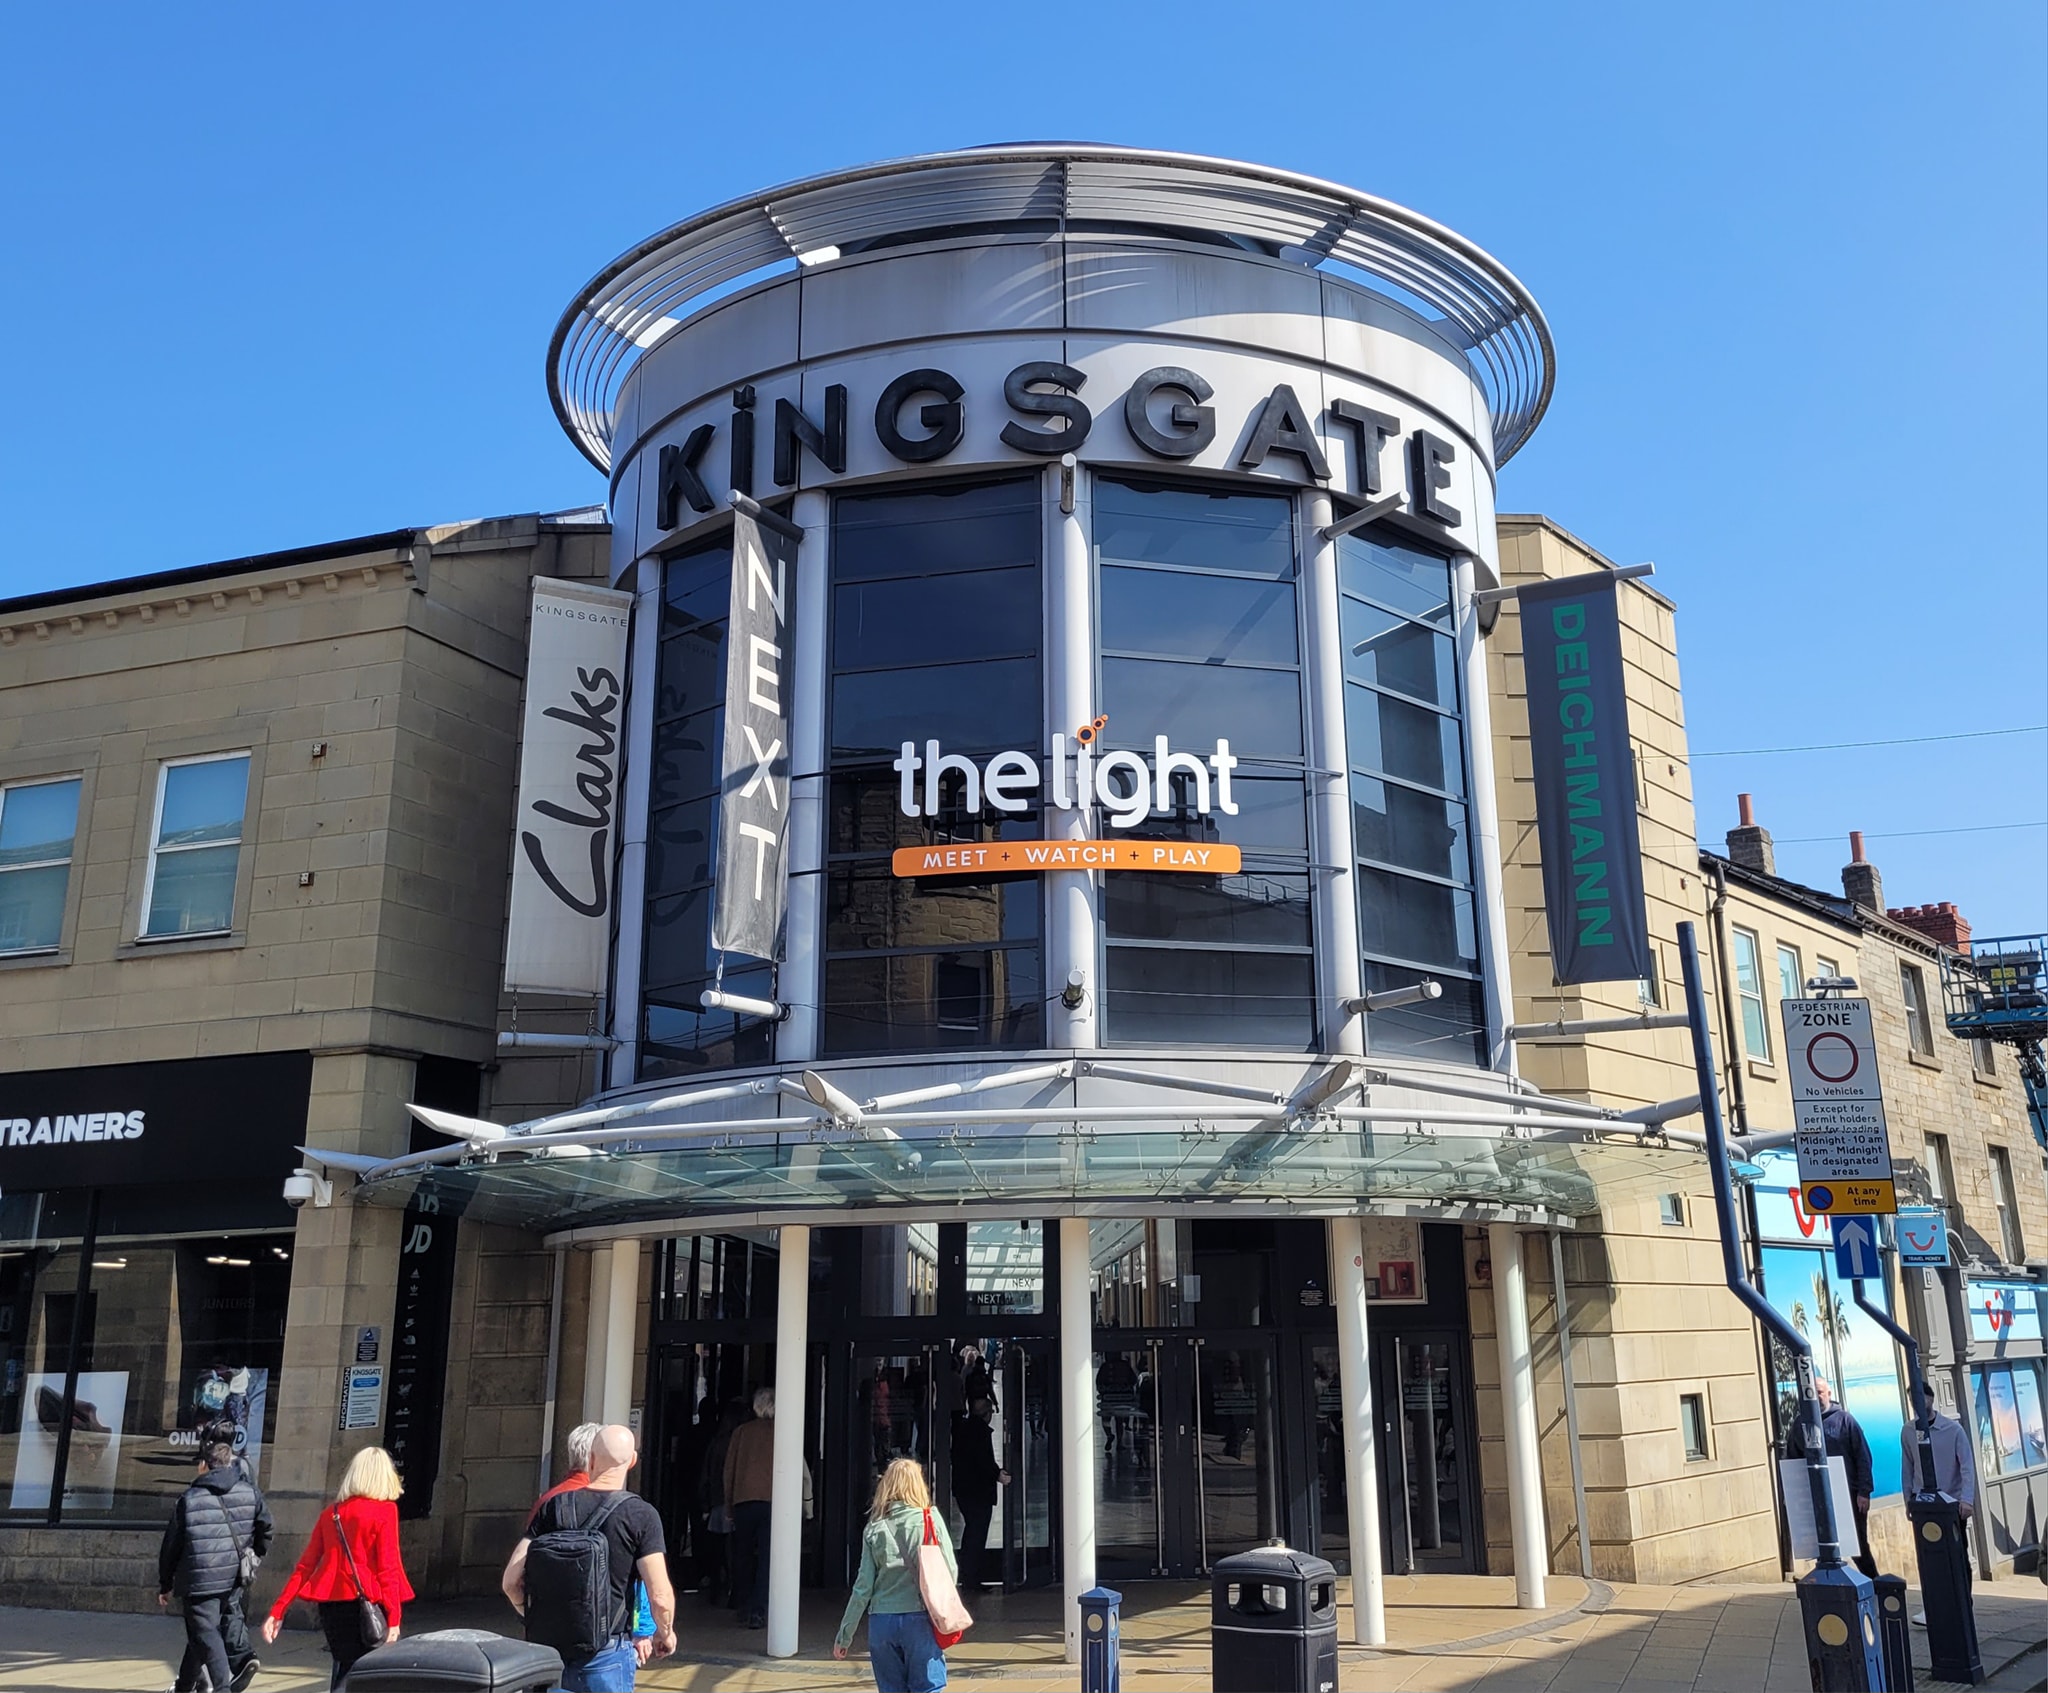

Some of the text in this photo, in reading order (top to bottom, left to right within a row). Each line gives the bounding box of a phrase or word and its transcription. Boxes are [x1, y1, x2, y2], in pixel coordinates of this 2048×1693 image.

[656, 360, 1462, 528] KINGSGATE
[535, 604, 628, 627] KINGSGATE
[739, 540, 786, 901] NEXT
[1552, 603, 1614, 947] DEICHMANN
[521, 666, 621, 918] Clarks
[923, 849, 988, 869] MEET
[1025, 847, 1115, 863] WATCH
[1153, 847, 1211, 865] PLAY
[1791, 1003, 1860, 1012] PEDESTRIAN
[1802, 1013, 1852, 1026] ZONE
[1806, 1087, 1864, 1096] No Vehicles
[1813, 1104, 1865, 1114] Except for
[1804, 1115, 1877, 1124] permit holders
[0, 1110, 146, 1146] TRAINERS
[1803, 1125, 1879, 1134] and for loading
[1800, 1135, 1846, 1145] Midnight
[1853, 1135, 1866, 1143] 10
[1803, 1147, 1810, 1155] 4
[1813, 1148, 1828, 1156] pm
[1836, 1145, 1883, 1155] Midnight
[1809, 1156, 1879, 1166] in designated
[1831, 1168, 1860, 1176] areas
[1847, 1186, 1881, 1196] At any
[1853, 1197, 1877, 1206] time
[404, 1224, 432, 1253] JD
[977, 1294, 1001, 1304] NEXT
[352, 1368, 382, 1376] KINGSGATE
[340, 1367, 350, 1429] INFORMATION
[168, 1431, 200, 1446] ONL
